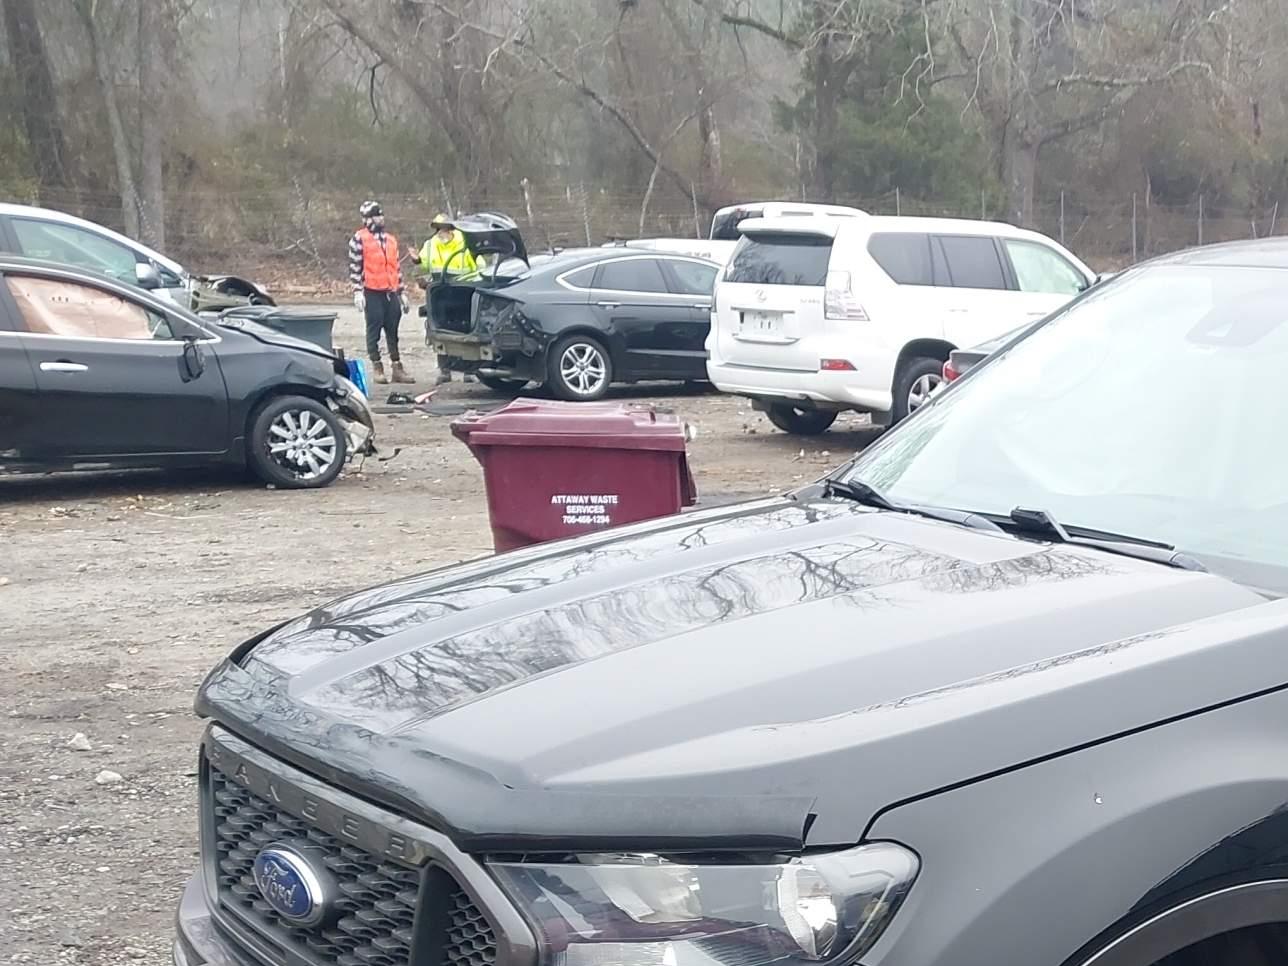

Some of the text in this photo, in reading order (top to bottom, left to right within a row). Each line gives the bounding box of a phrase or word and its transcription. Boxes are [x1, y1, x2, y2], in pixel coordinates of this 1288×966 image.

[551, 495, 618, 504] ATTAWAY WASTE
[566, 505, 605, 514] SERVICES
[260, 859, 297, 908] Ford
